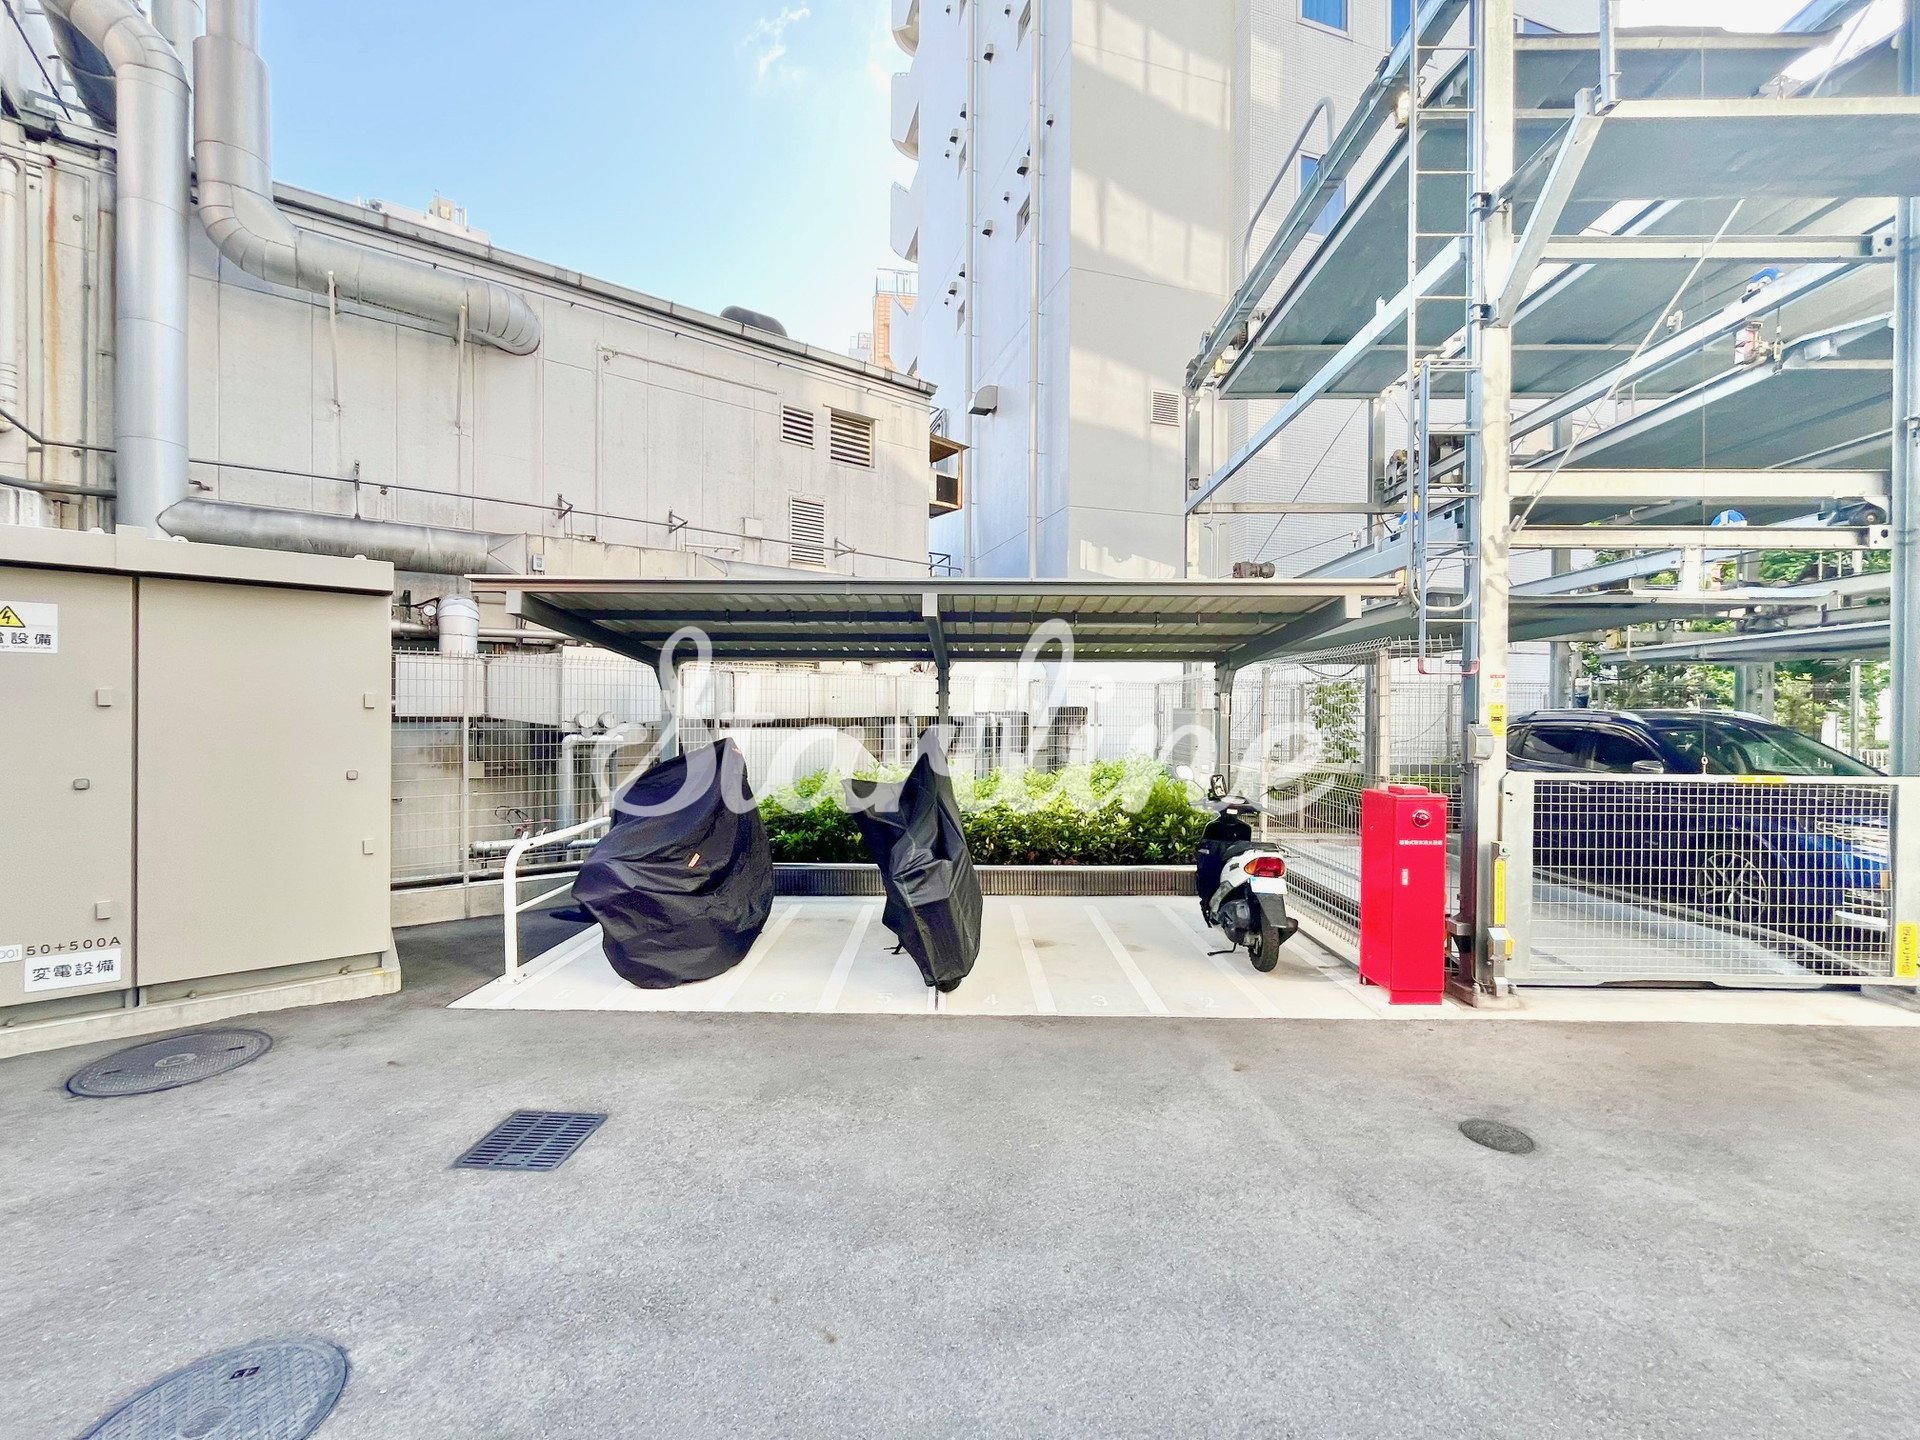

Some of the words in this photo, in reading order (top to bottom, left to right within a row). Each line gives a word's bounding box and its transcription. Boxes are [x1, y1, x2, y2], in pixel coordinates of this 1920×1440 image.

[0, 631, 52, 646] 設備
[26, 936, 121, 956] 50+500A
[32, 959, 114, 982] 変電設備
[1090, 994, 1108, 1007] 3
